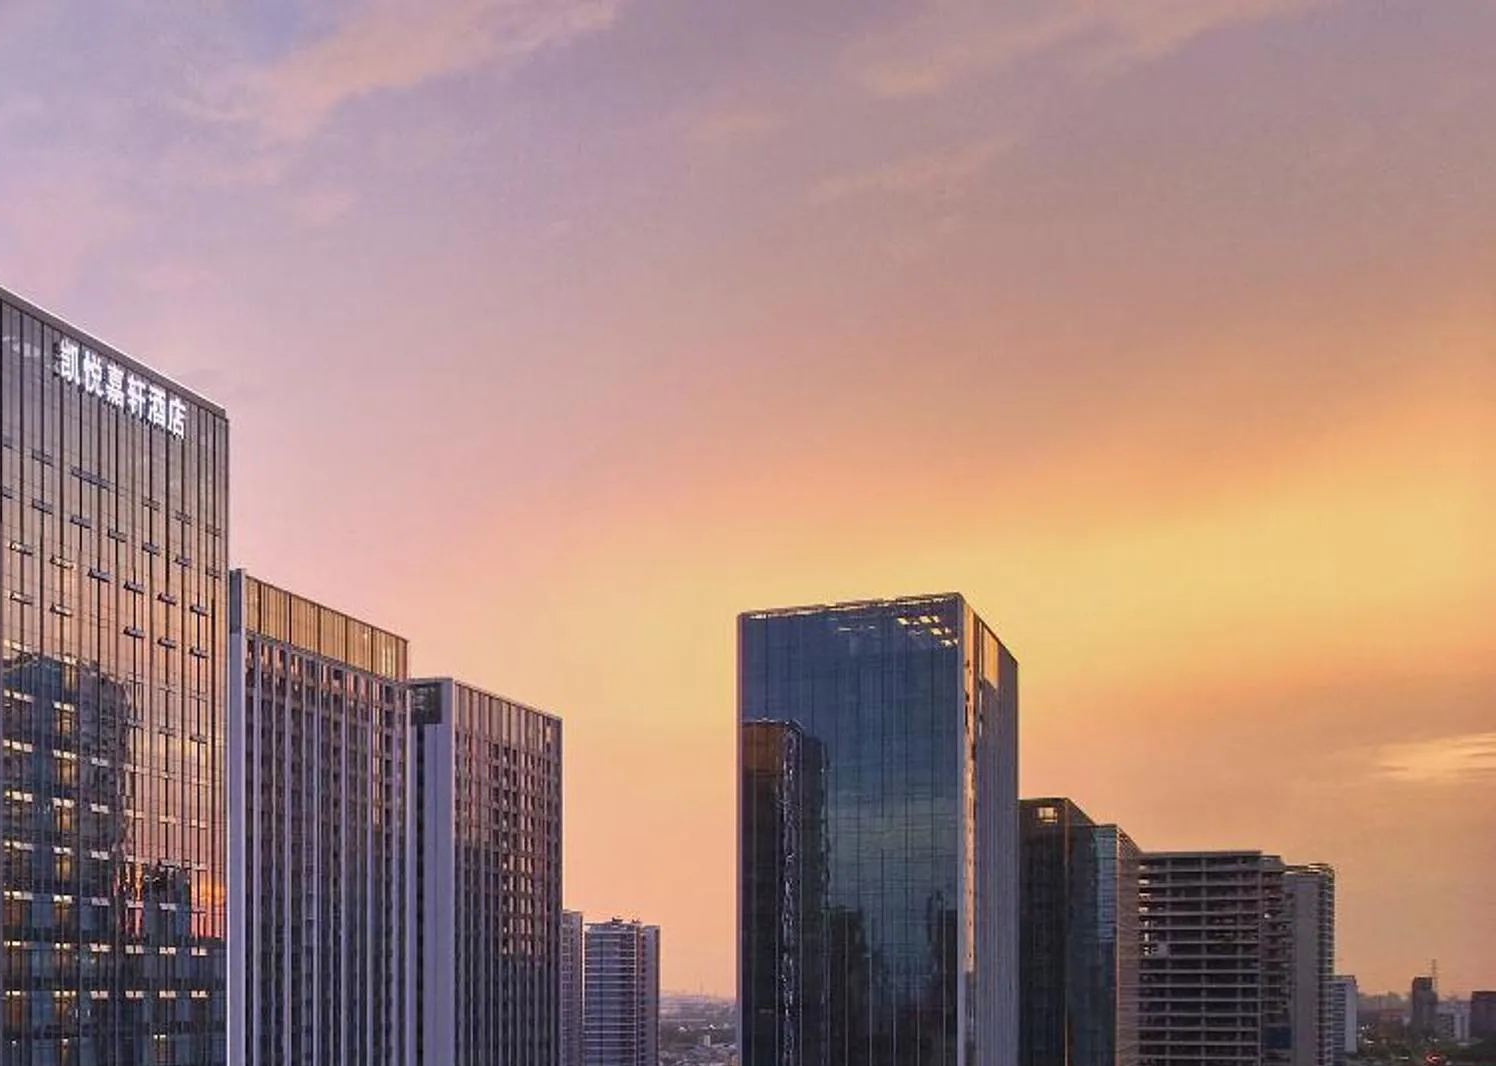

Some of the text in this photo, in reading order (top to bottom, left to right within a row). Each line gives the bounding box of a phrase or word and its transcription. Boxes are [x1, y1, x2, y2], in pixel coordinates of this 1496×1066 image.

[60, 338, 186, 440] 凯悦嘉轩酒店
